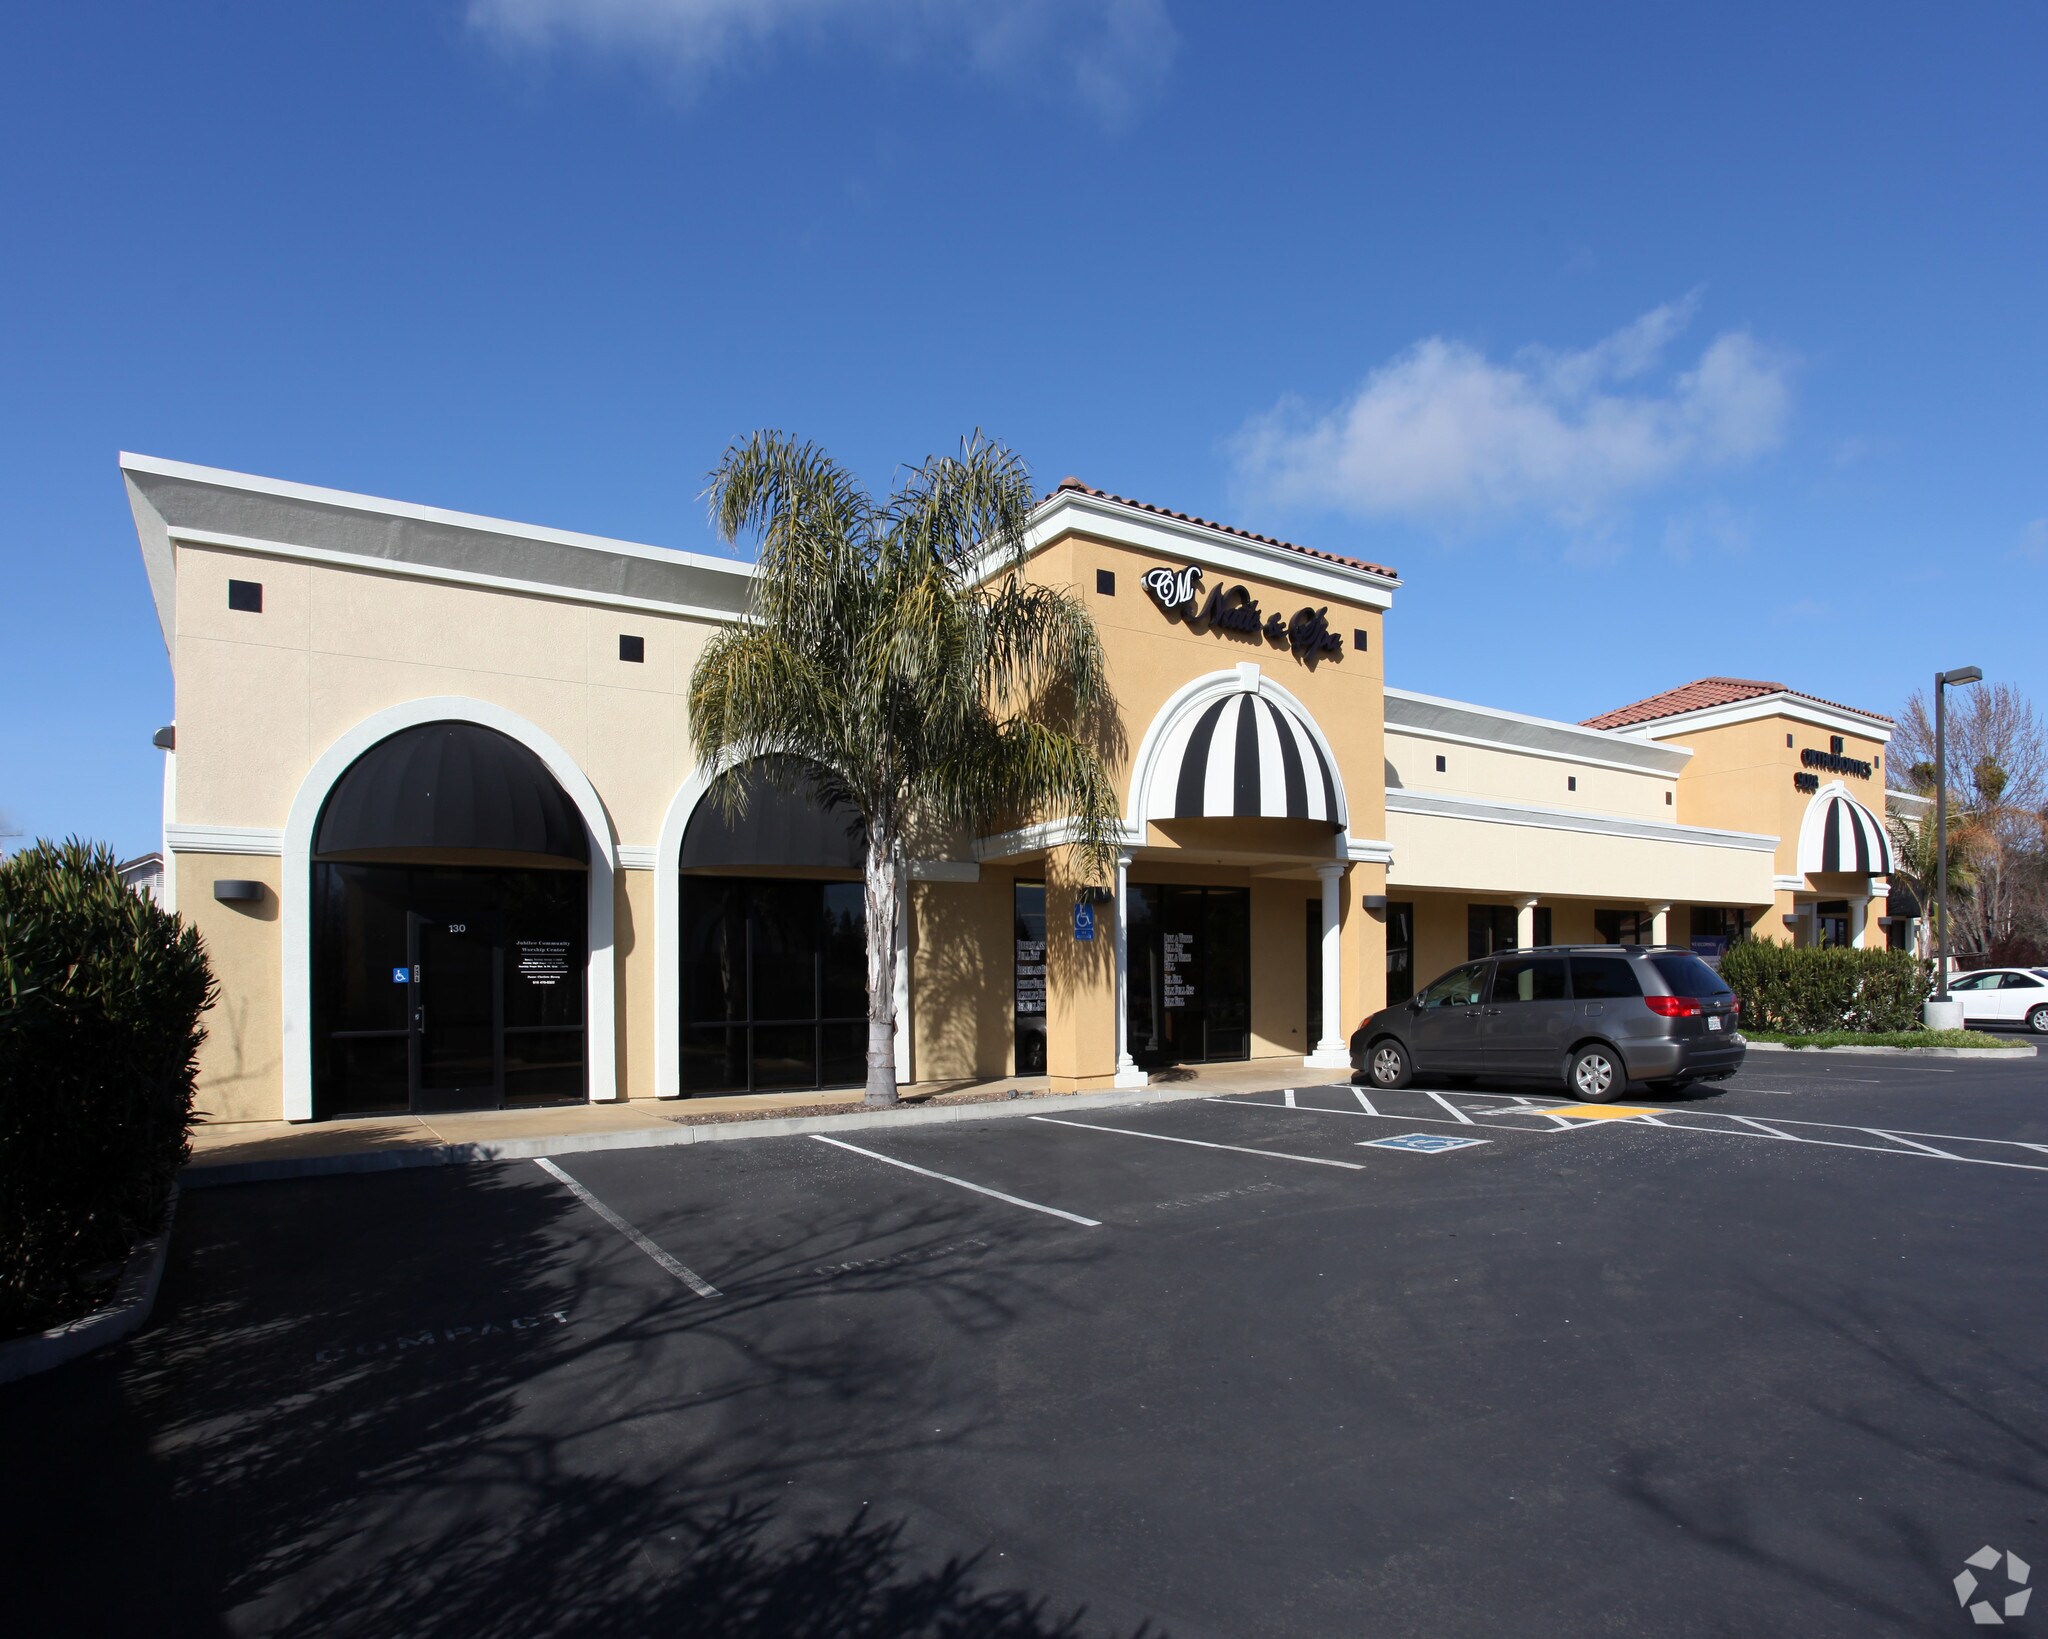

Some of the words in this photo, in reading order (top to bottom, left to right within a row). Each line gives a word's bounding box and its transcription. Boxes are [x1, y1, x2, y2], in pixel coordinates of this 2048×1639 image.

[1181, 582, 1261, 632] Nails
[1263, 612, 1287, 638] &
[1288, 606, 1344, 661] Spa
[1801, 748, 1871, 778] ORTHODONTICS
[448, 924, 466, 933] 130
